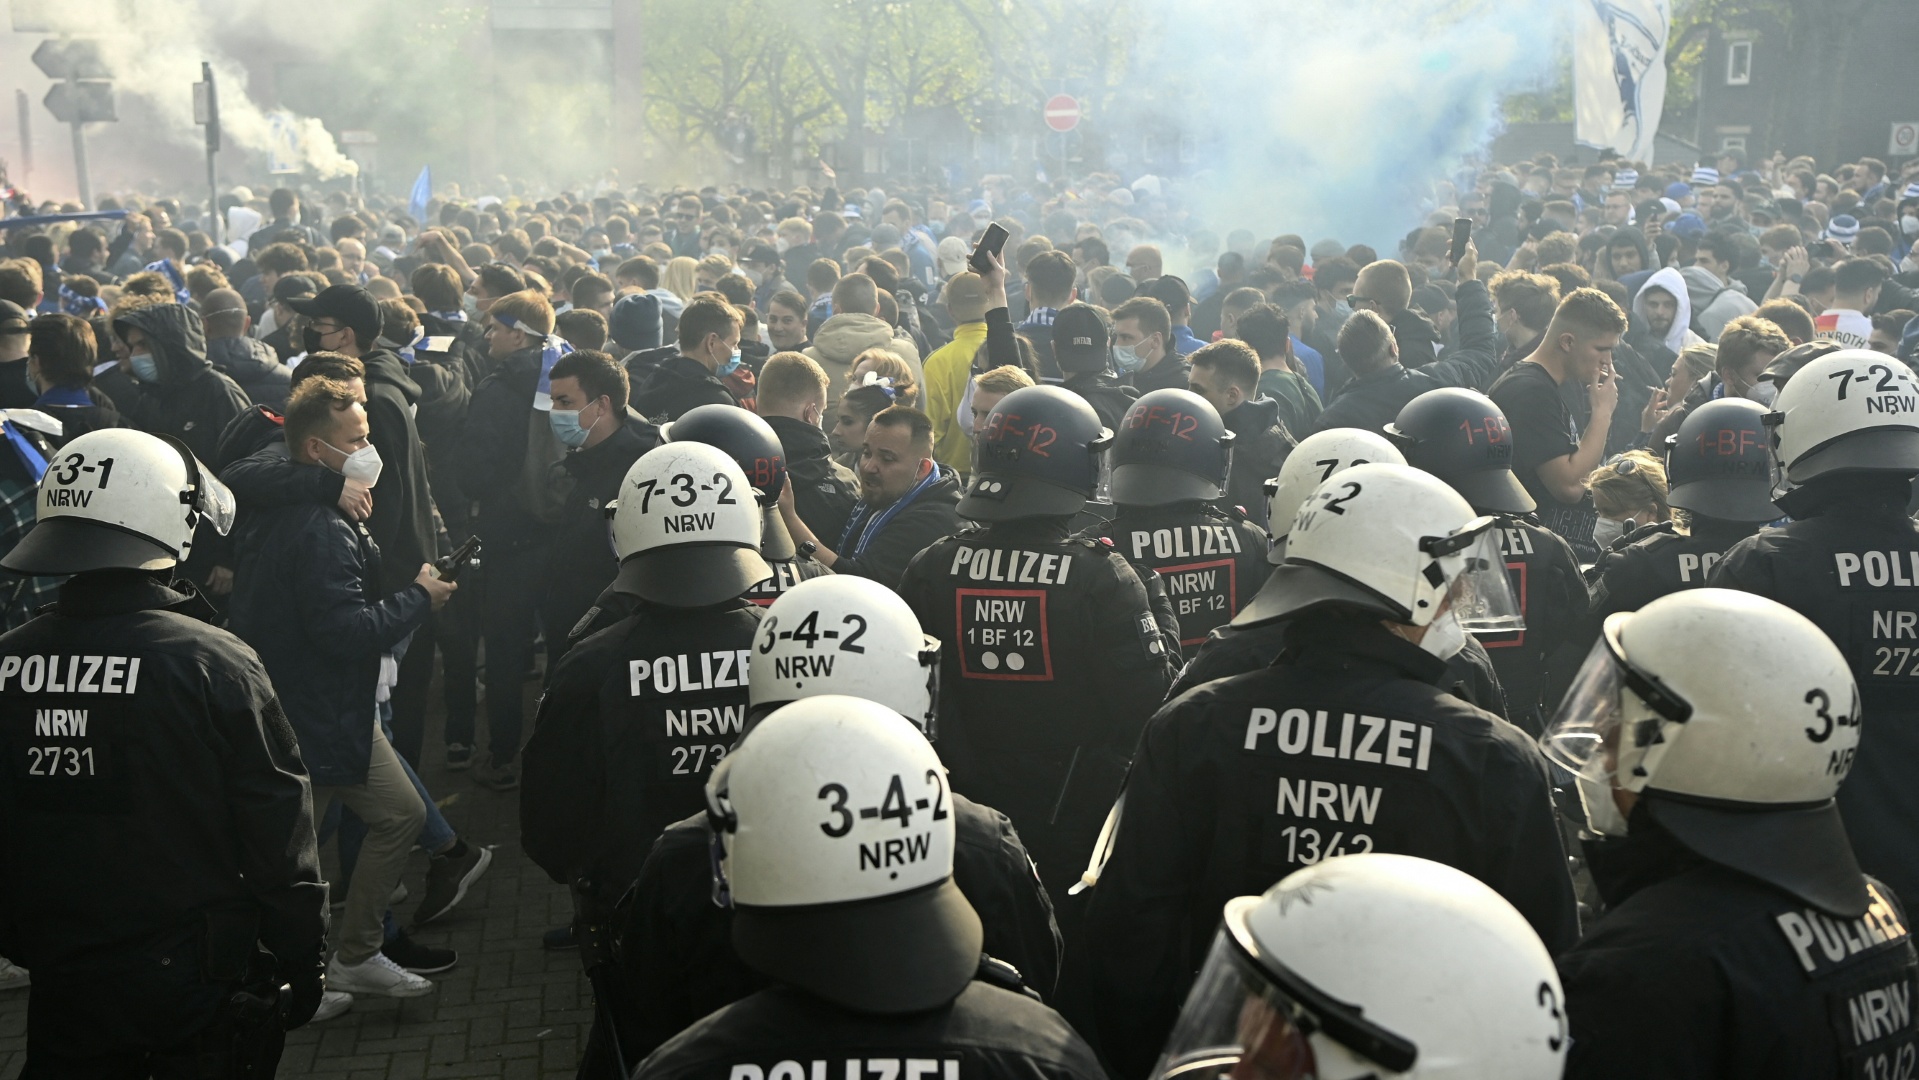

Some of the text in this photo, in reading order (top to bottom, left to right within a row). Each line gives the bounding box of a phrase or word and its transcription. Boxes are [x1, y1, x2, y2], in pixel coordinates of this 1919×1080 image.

[1866, 395, 1915, 415] NRW
[46, 488, 94, 508] NRW
[637, 472, 737, 515] 7-3-2
[663, 512, 715, 534] NRW
[1131, 525, 1242, 559] POLIZEI
[950, 545, 1072, 585] POLIZEI
[1170, 569, 1216, 596] NRW
[975, 599, 1026, 623] NRW
[1179, 594, 1225, 615] BF 12
[759, 610, 868, 655] 3-4-2
[967, 627, 1034, 647] 1 BF 12
[0, 654, 141, 694] POLIZEI
[776, 654, 835, 679] NRW
[35, 709, 88, 737] NRW
[665, 704, 746, 737] NRW
[1244, 707, 1433, 771] POLIZEI
[27, 746, 95, 776] 2731
[671, 743, 737, 775] 273
[817, 769, 948, 838] 3-4-2
[1276, 776, 1383, 825] NRW
[859, 832, 931, 871] NRW
[1849, 979, 1910, 1047] NRW
